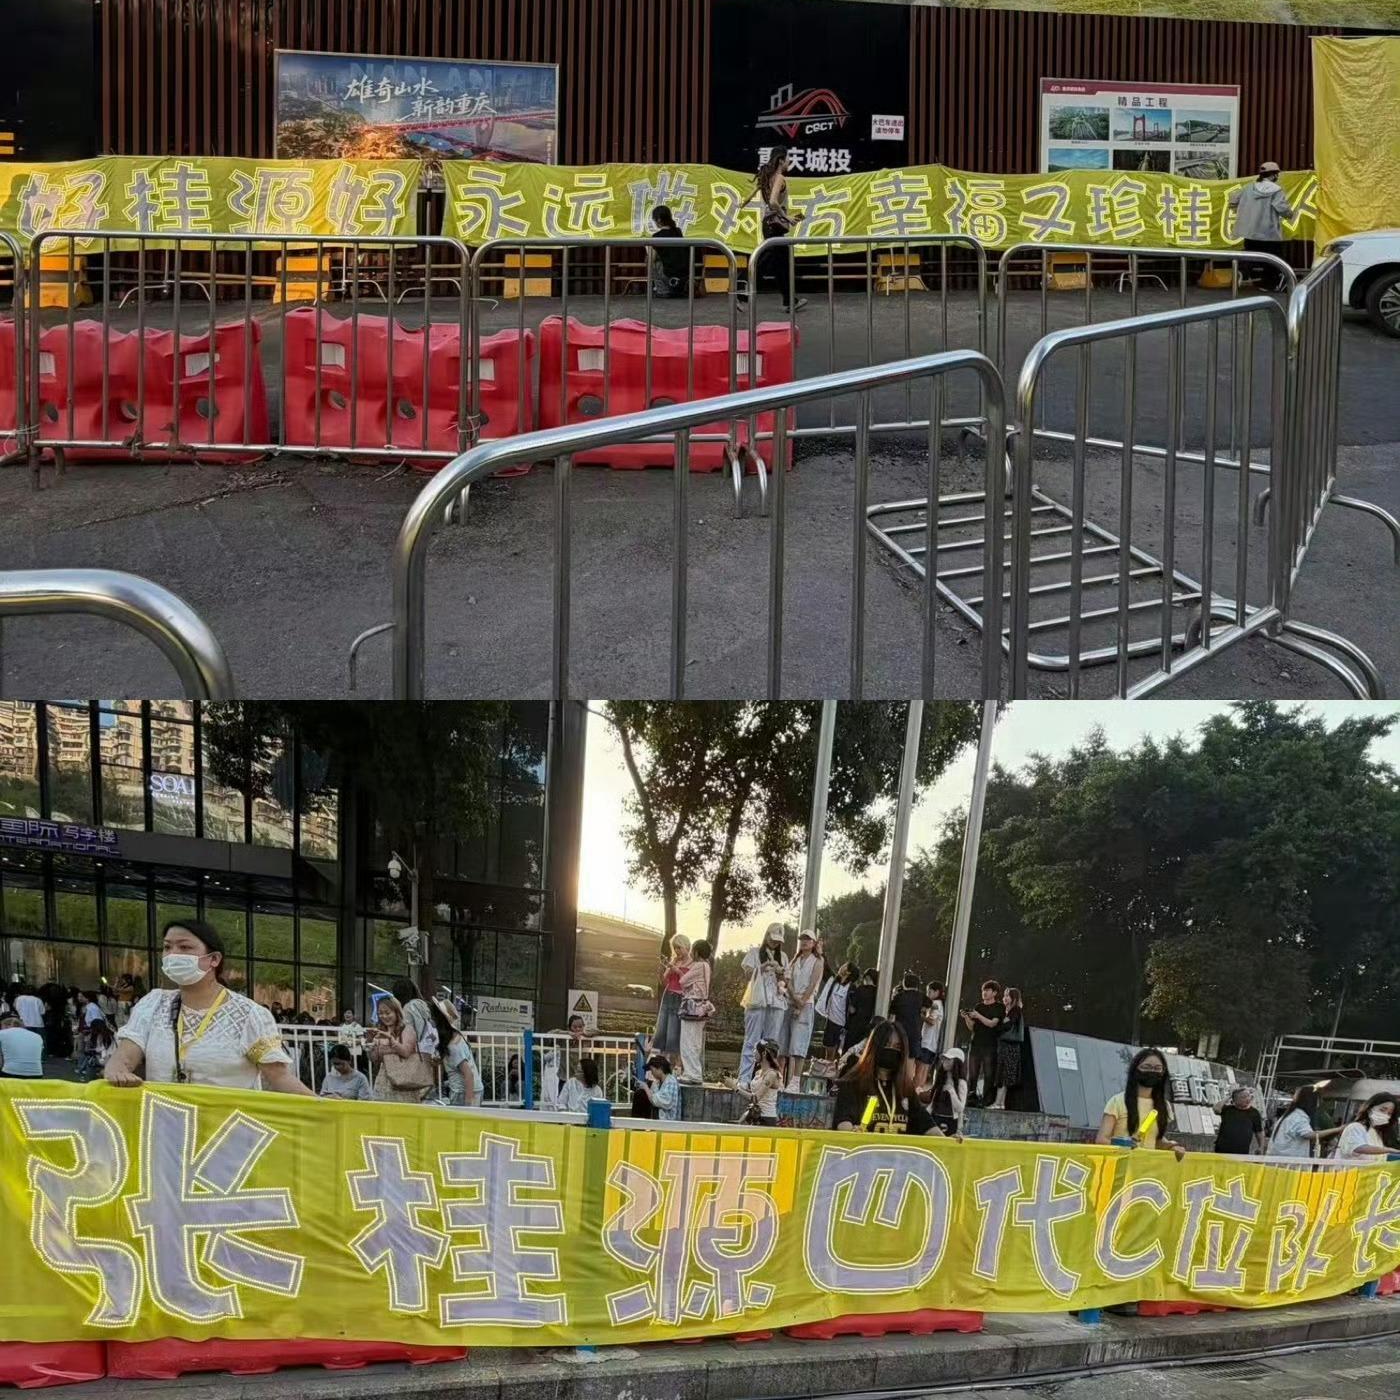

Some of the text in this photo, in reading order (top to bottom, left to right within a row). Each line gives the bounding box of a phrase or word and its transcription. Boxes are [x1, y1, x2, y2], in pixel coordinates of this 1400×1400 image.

[344, 74, 440, 104] 雄奇山水
[1117, 96, 1168, 108] 精品工程
[399, 92, 498, 121] 新韵重庆
[17, 161, 408, 251] 好桂源好
[149, 774, 195, 795] SOA
[63, 824, 117, 843] 写字楼
[10, 1091, 1400, 1327] 张桂源四代C位队长
